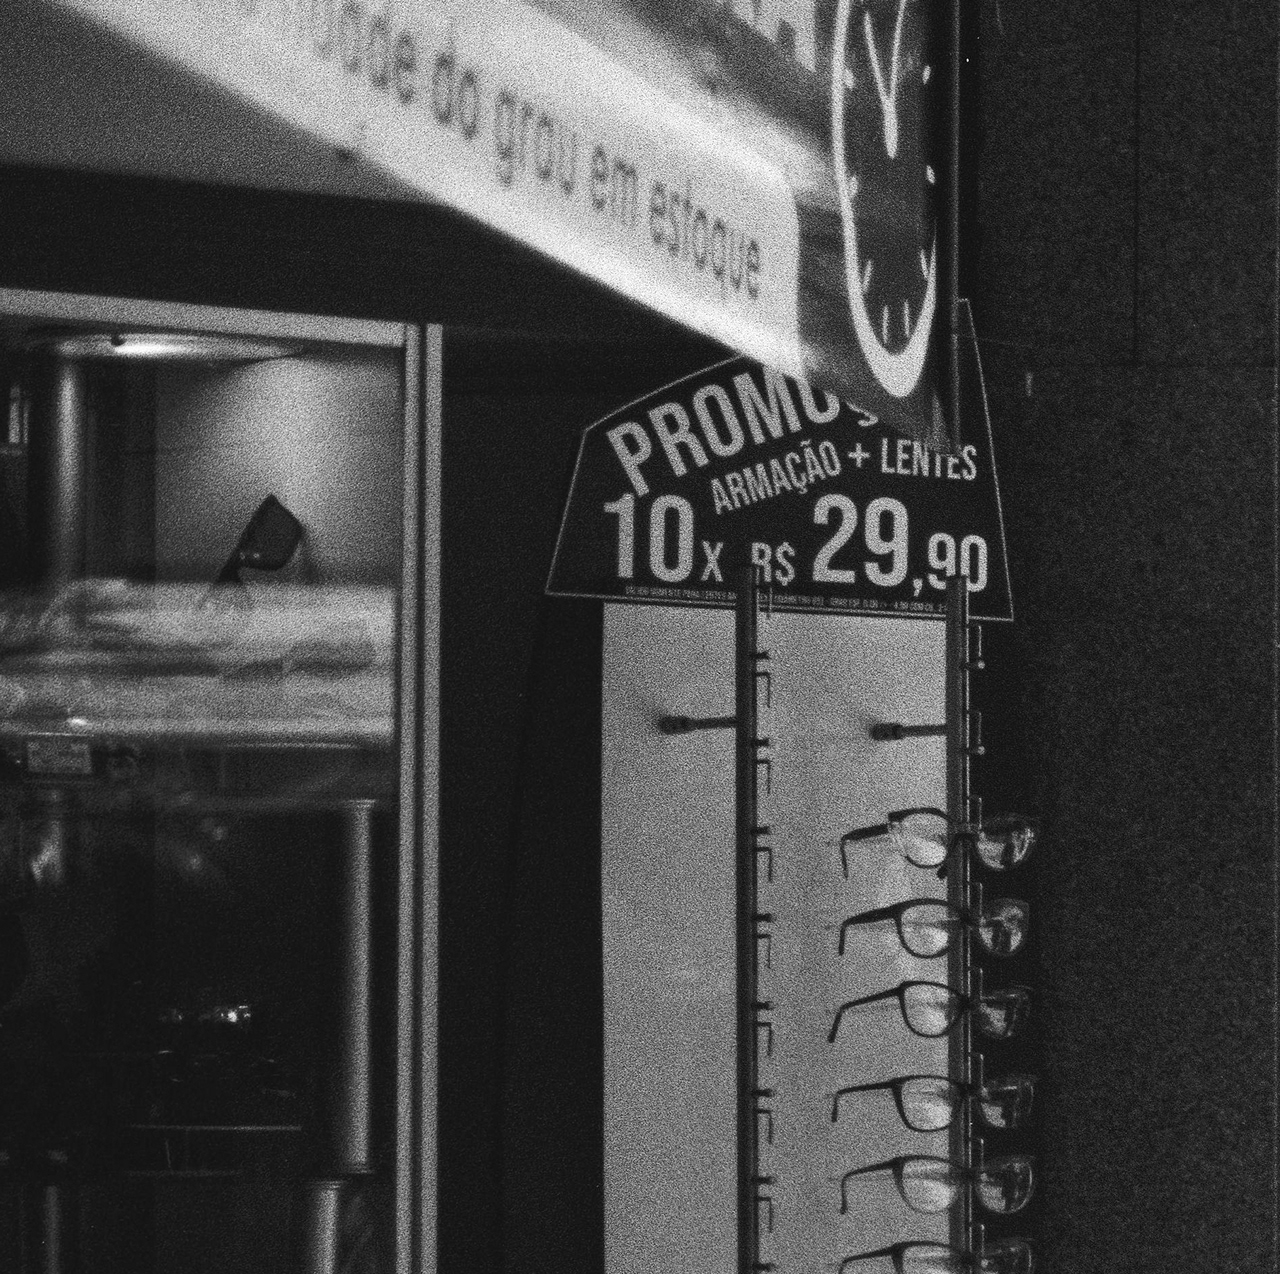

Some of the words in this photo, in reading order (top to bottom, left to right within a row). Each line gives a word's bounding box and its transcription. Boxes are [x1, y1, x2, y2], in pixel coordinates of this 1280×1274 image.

[431, 17, 480, 140] do
[494, 89, 578, 196] grau
[590, 144, 638, 229] em
[649, 178, 761, 302] estoque
[606, 366, 878, 497] PROMO
[711, 439, 841, 515] ARMAÇÃO
[848, 443, 870, 467] +
[881, 437, 977, 480] LENTES
[751, 541, 795, 586] R$
